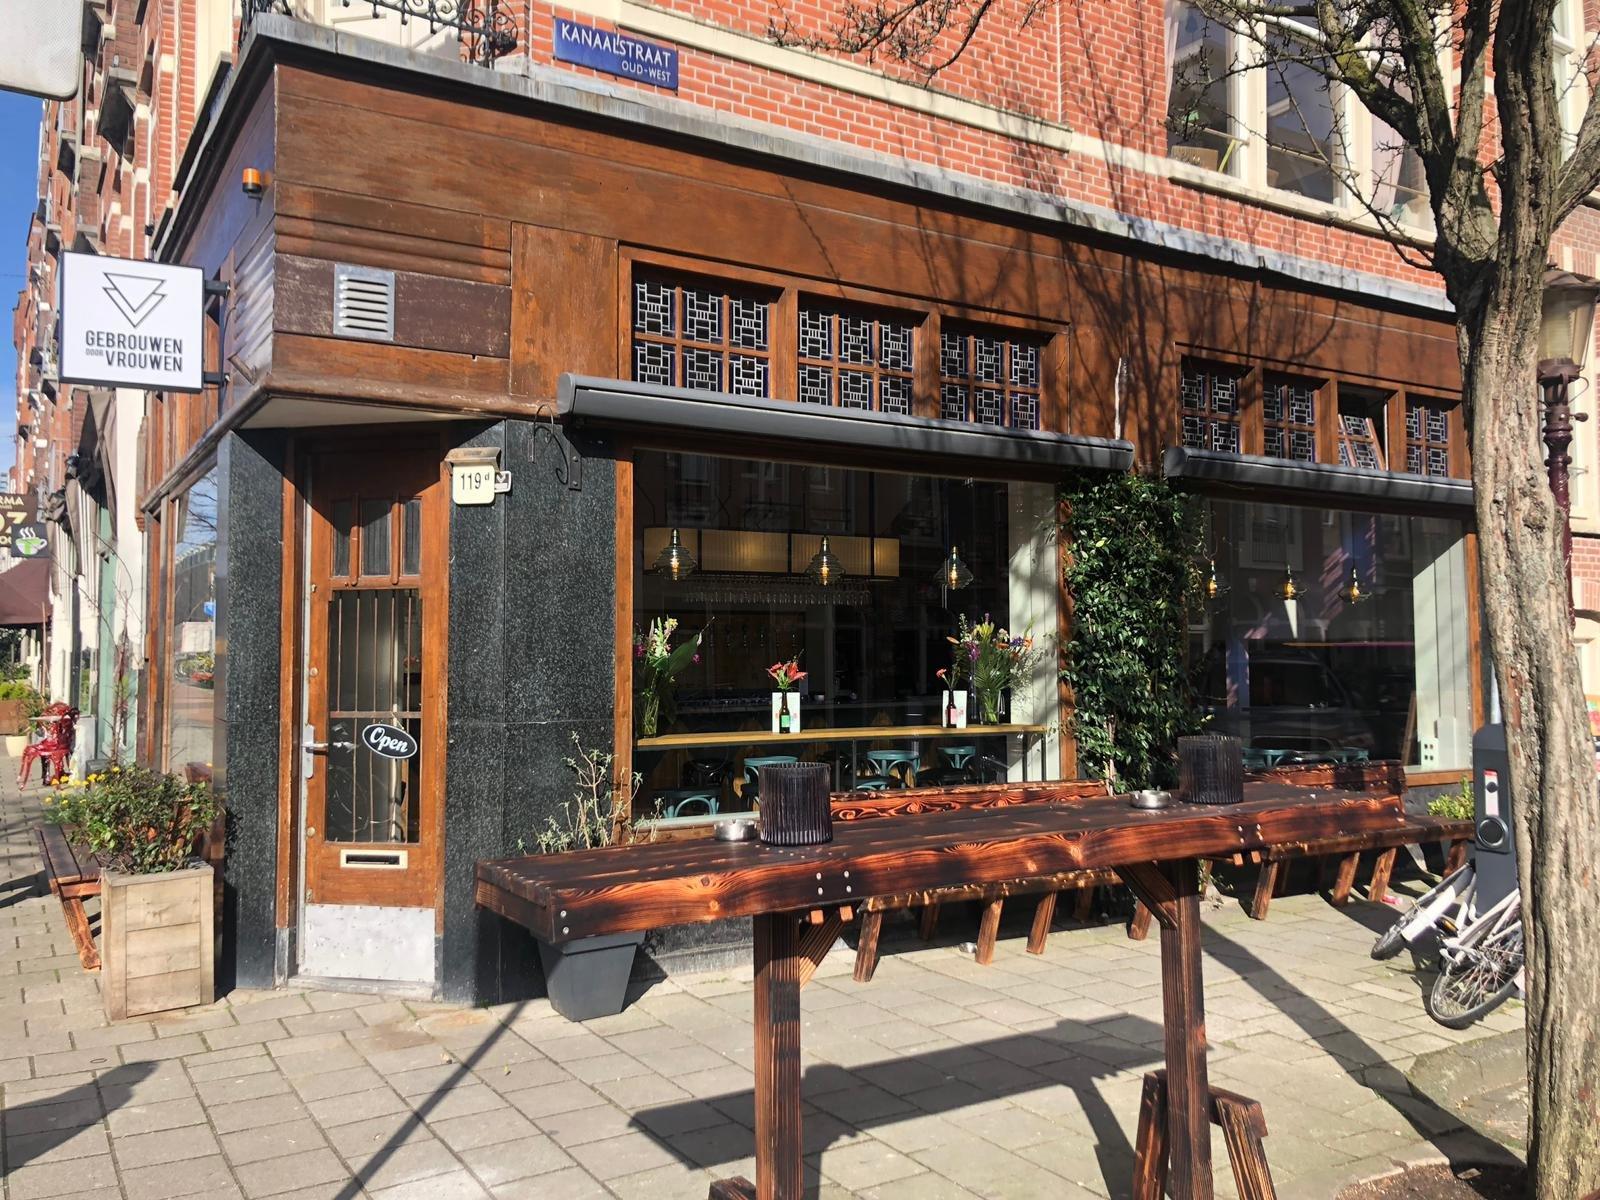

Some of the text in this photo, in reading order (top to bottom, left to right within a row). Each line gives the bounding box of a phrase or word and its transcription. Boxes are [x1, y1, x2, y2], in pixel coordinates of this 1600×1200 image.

[561, 22, 671, 69] KANAALSTRAAT
[621, 60, 671, 82] OUD-WEST
[85, 329, 183, 355] GEBROUWEN
[105, 350, 183, 373] VROUWEN
[369, 726, 409, 753] Open
